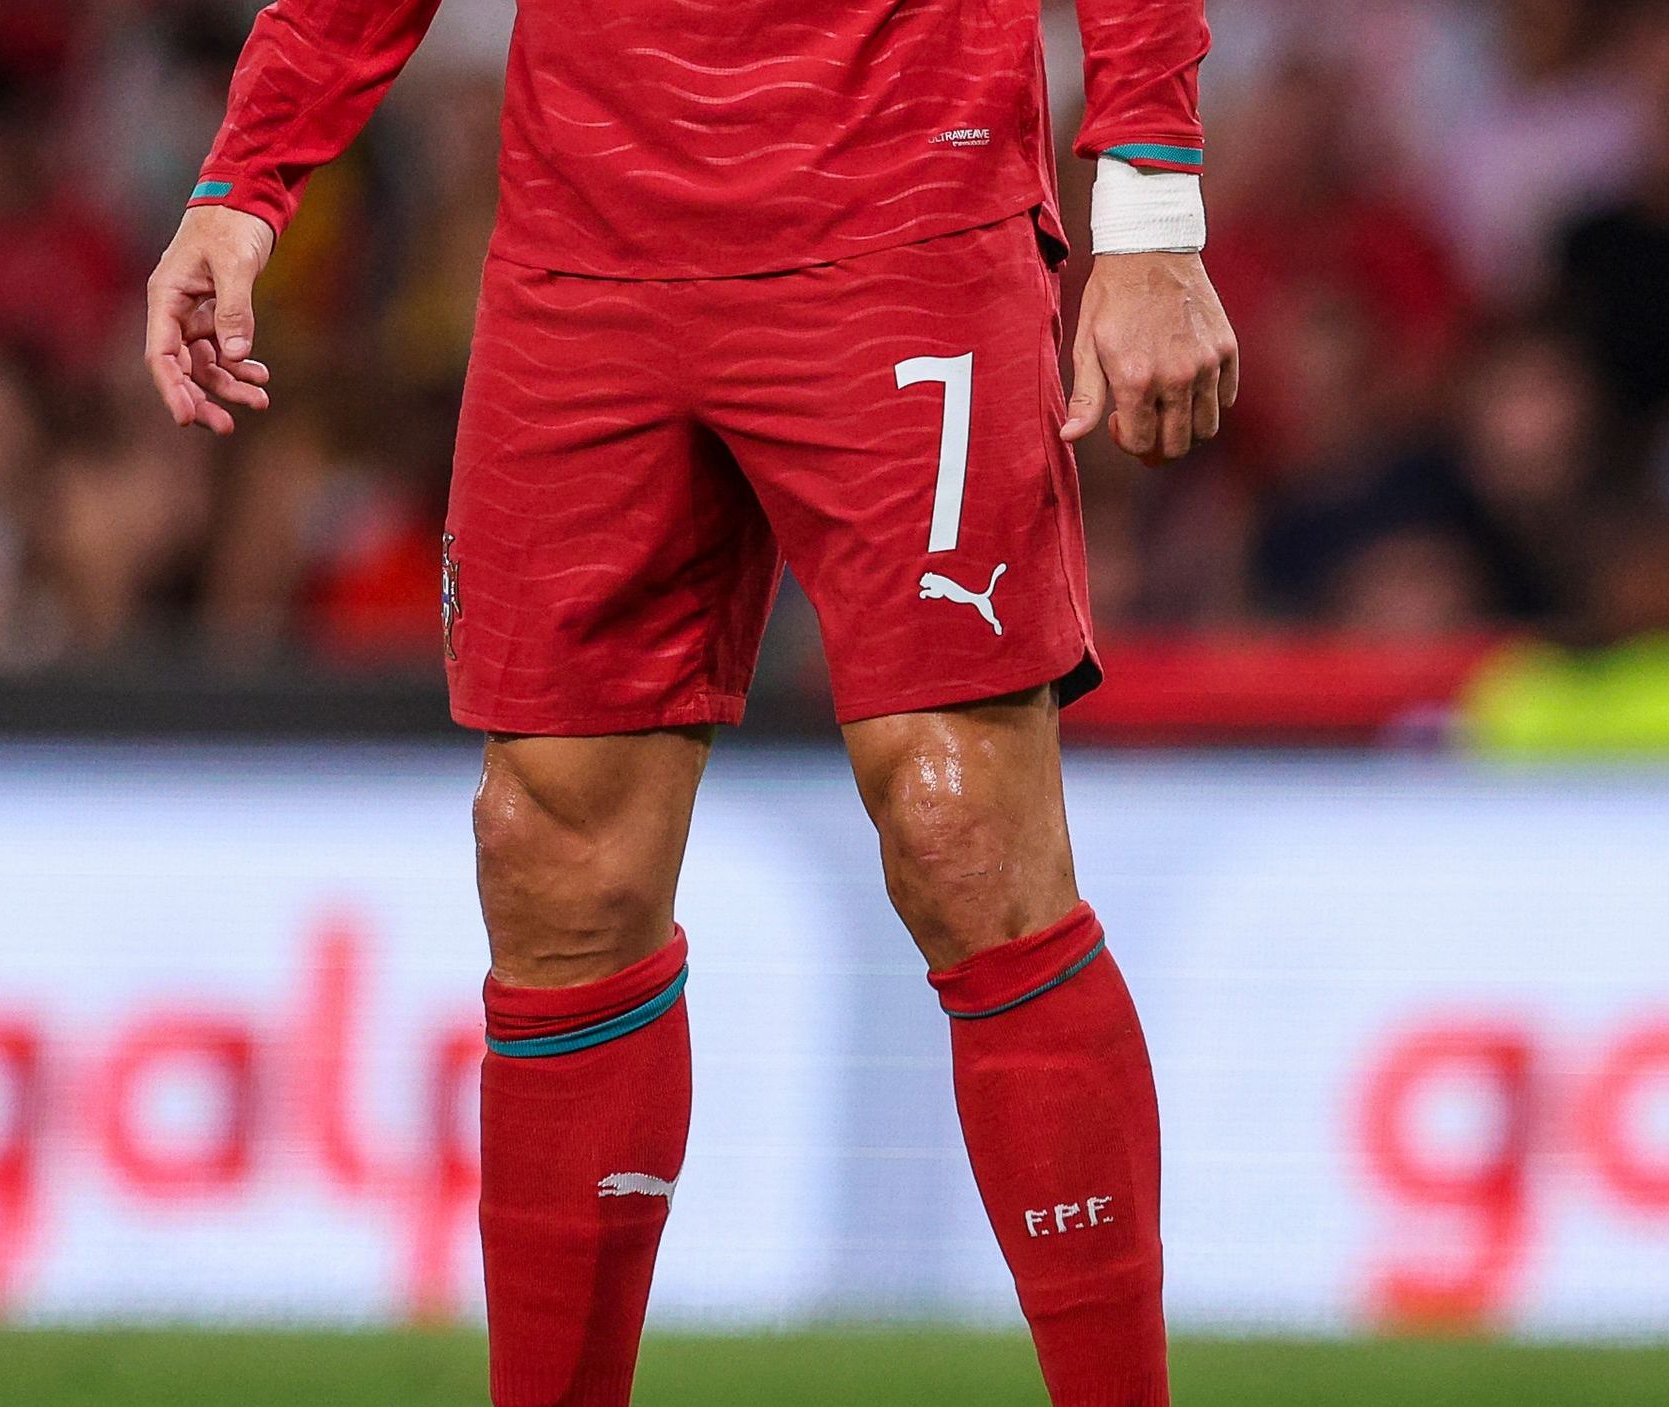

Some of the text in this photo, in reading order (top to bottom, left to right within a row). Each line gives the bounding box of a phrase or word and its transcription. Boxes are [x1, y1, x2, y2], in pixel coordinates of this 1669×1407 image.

[927, 129, 990, 144] ULTRAWEAVE
[894, 351, 974, 554] 7
[1024, 1196, 1114, 1237] F.P.F.
